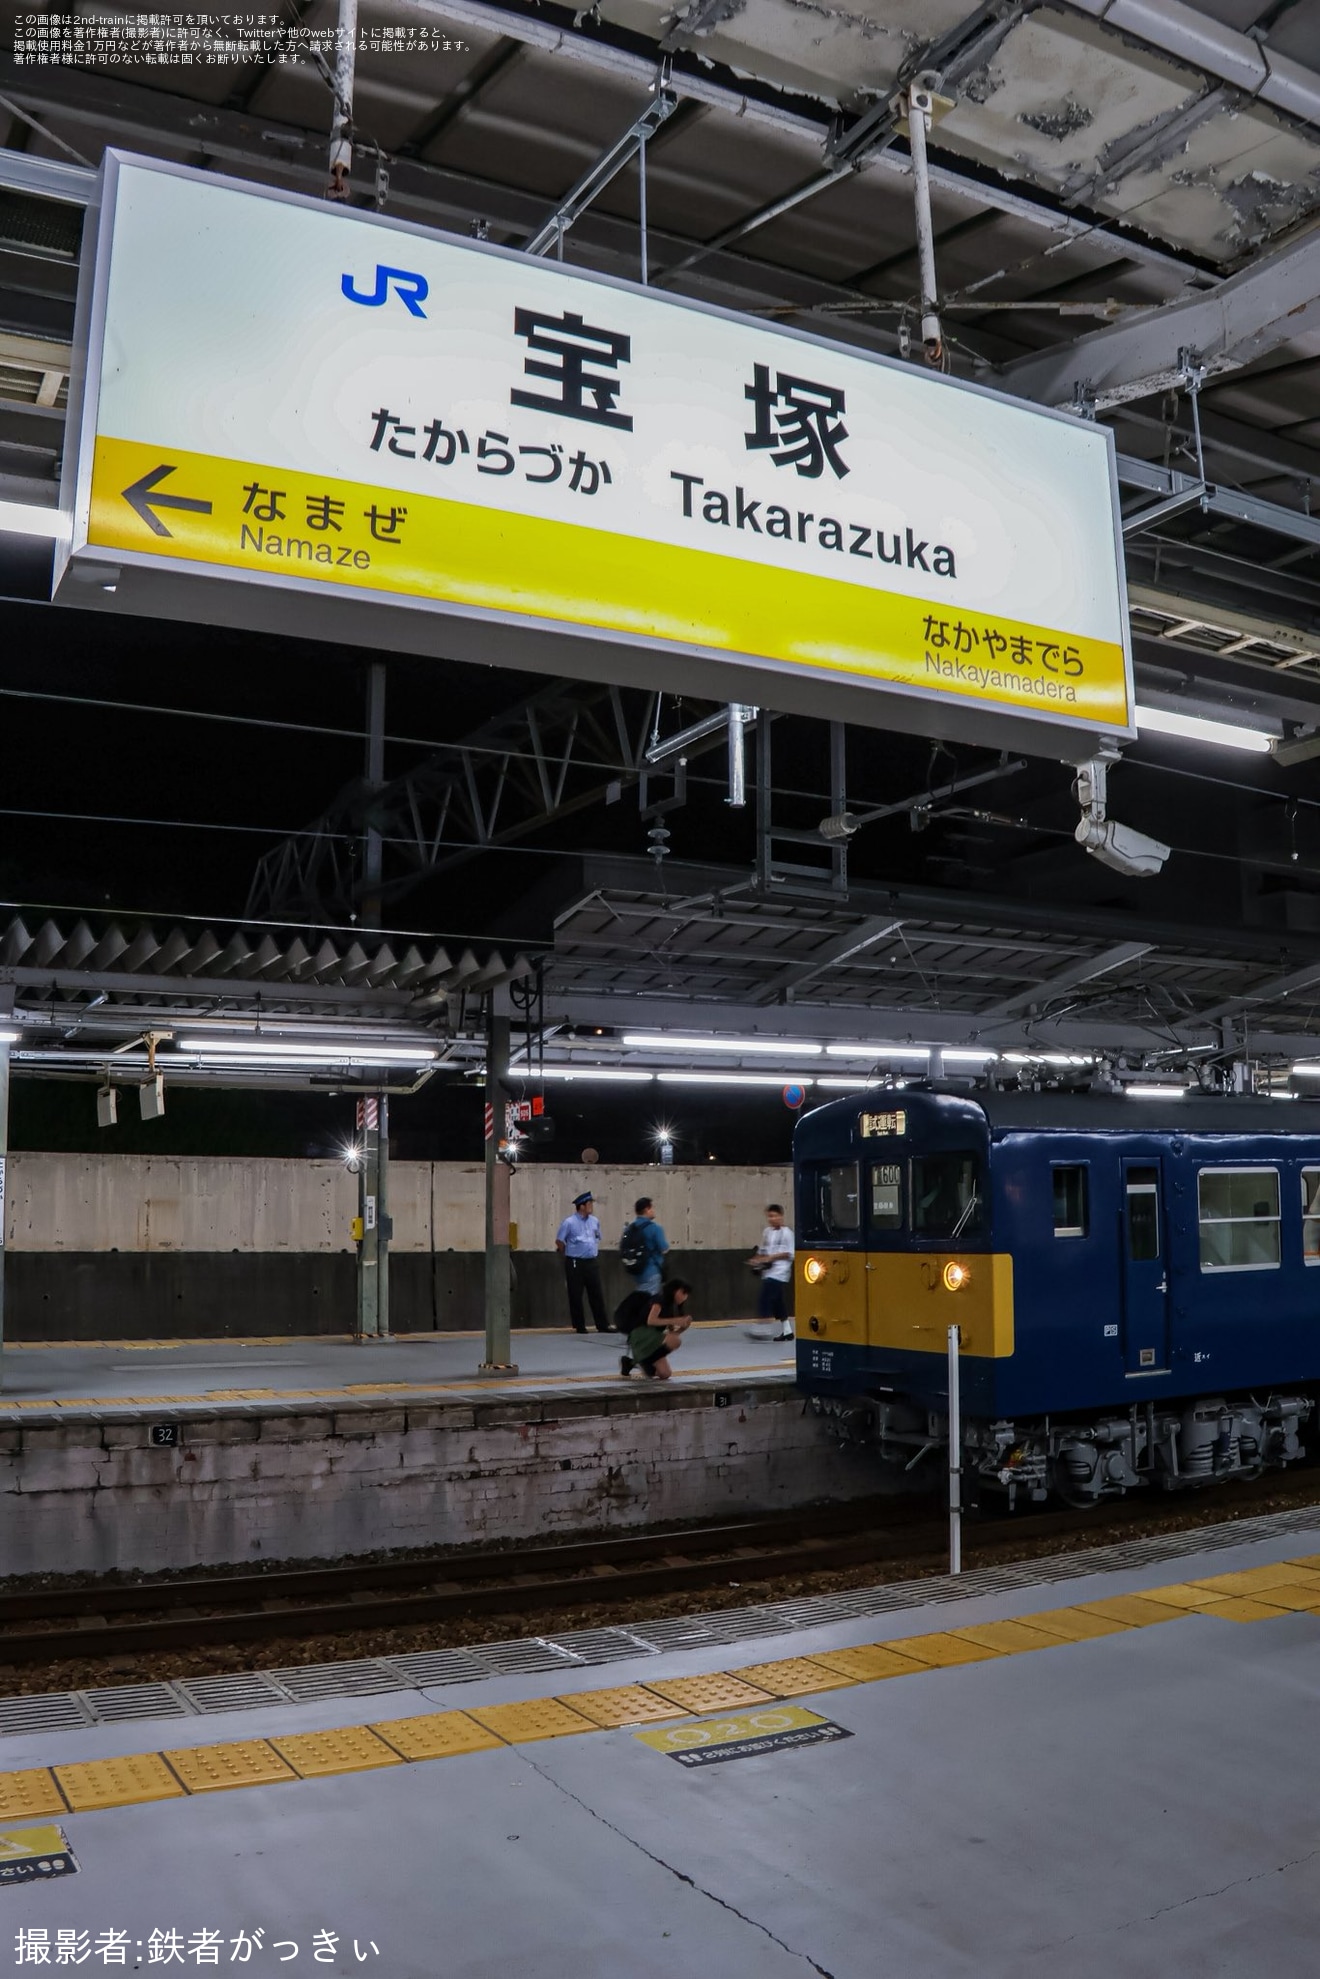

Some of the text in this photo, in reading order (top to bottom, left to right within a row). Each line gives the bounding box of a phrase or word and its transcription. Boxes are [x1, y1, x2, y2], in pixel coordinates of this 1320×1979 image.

[341, 264, 429, 319] JR
[510, 306, 851, 480] 宝塚
[371, 407, 613, 496] たからづか
[241, 481, 408, 545] なまぜ
[670, 470, 957, 579] Takarazuka
[240, 524, 372, 571] Namaze
[922, 614, 1085, 677] なかやまでら
[925, 650, 1077, 703] Nakayamadera
[869, 1114, 897, 1130] 試運転
[159, 1428, 174, 1442] 32
